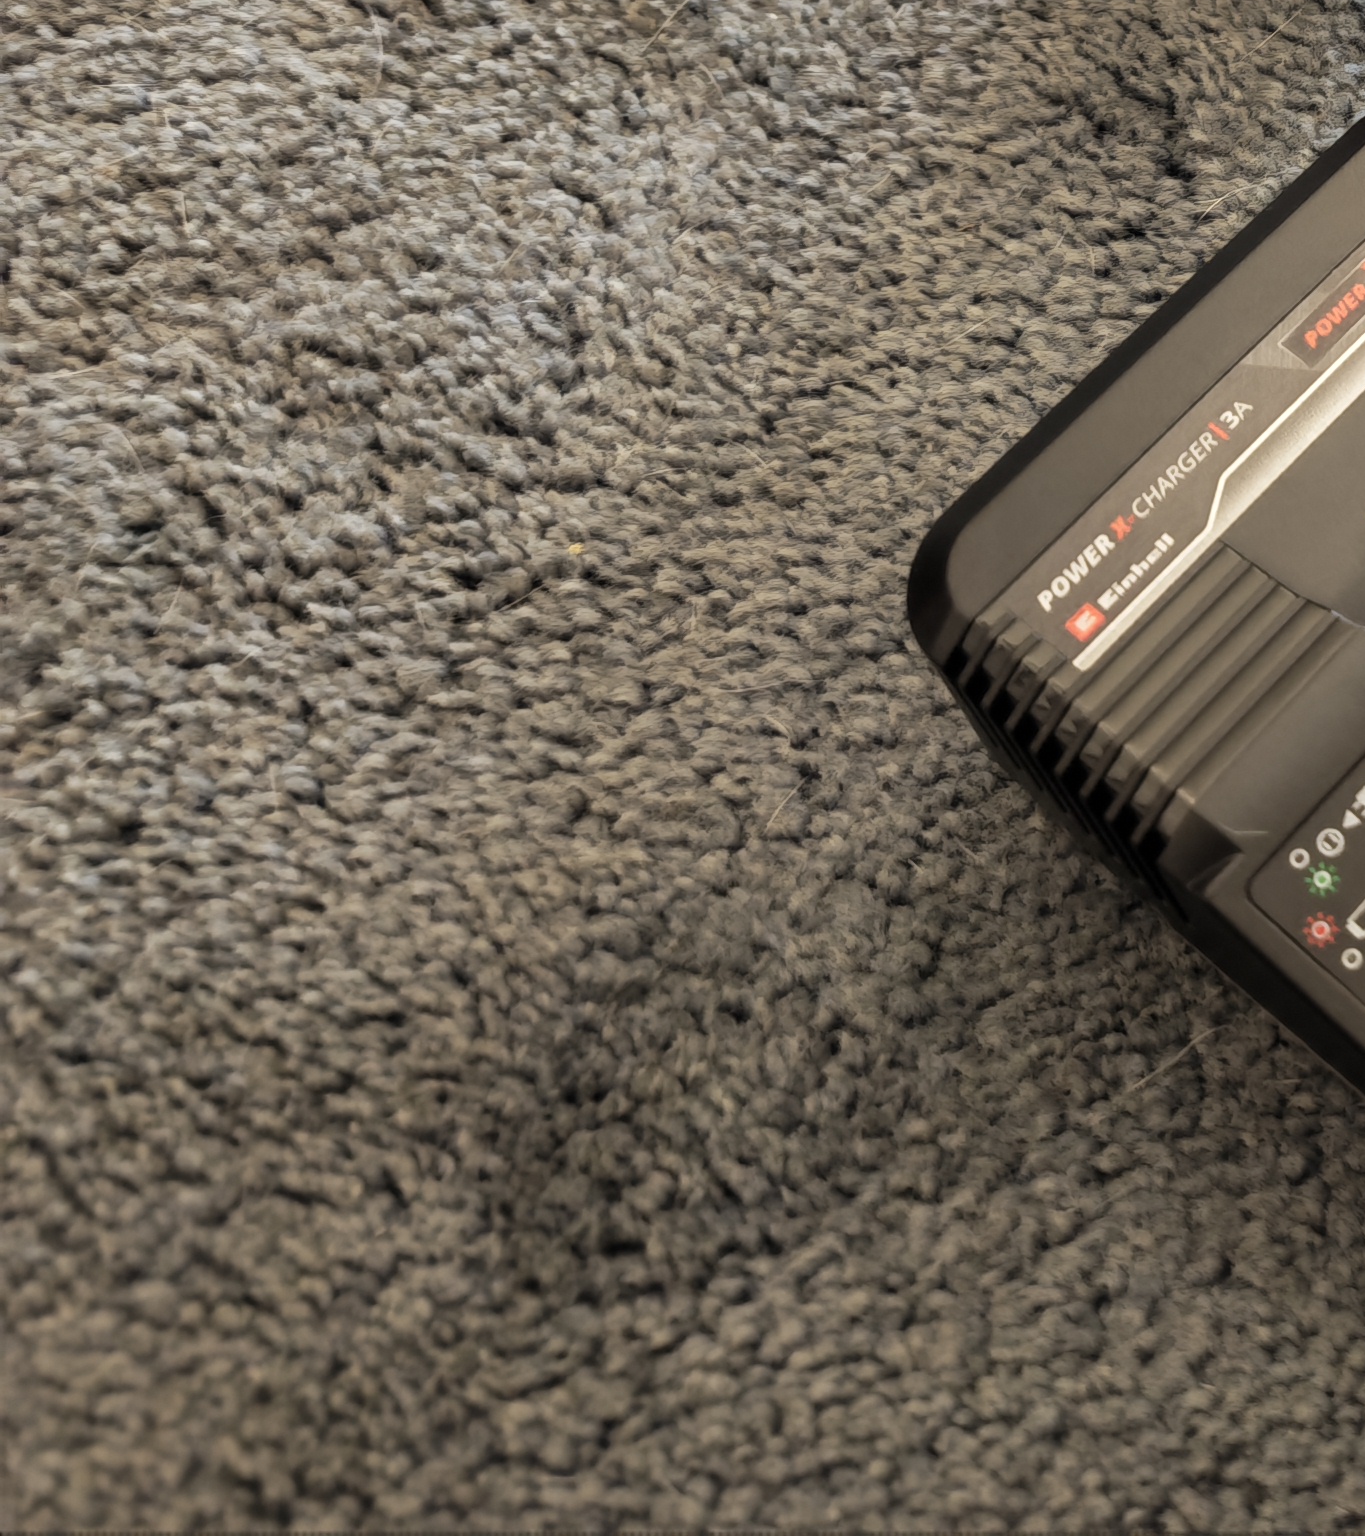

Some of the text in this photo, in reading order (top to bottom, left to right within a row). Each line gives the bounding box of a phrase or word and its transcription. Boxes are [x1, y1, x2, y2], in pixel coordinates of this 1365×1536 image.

[1036, 533, 1116, 612] POWER
[1219, 401, 1254, 430] 3A
[1097, 532, 1175, 611] Einhell
